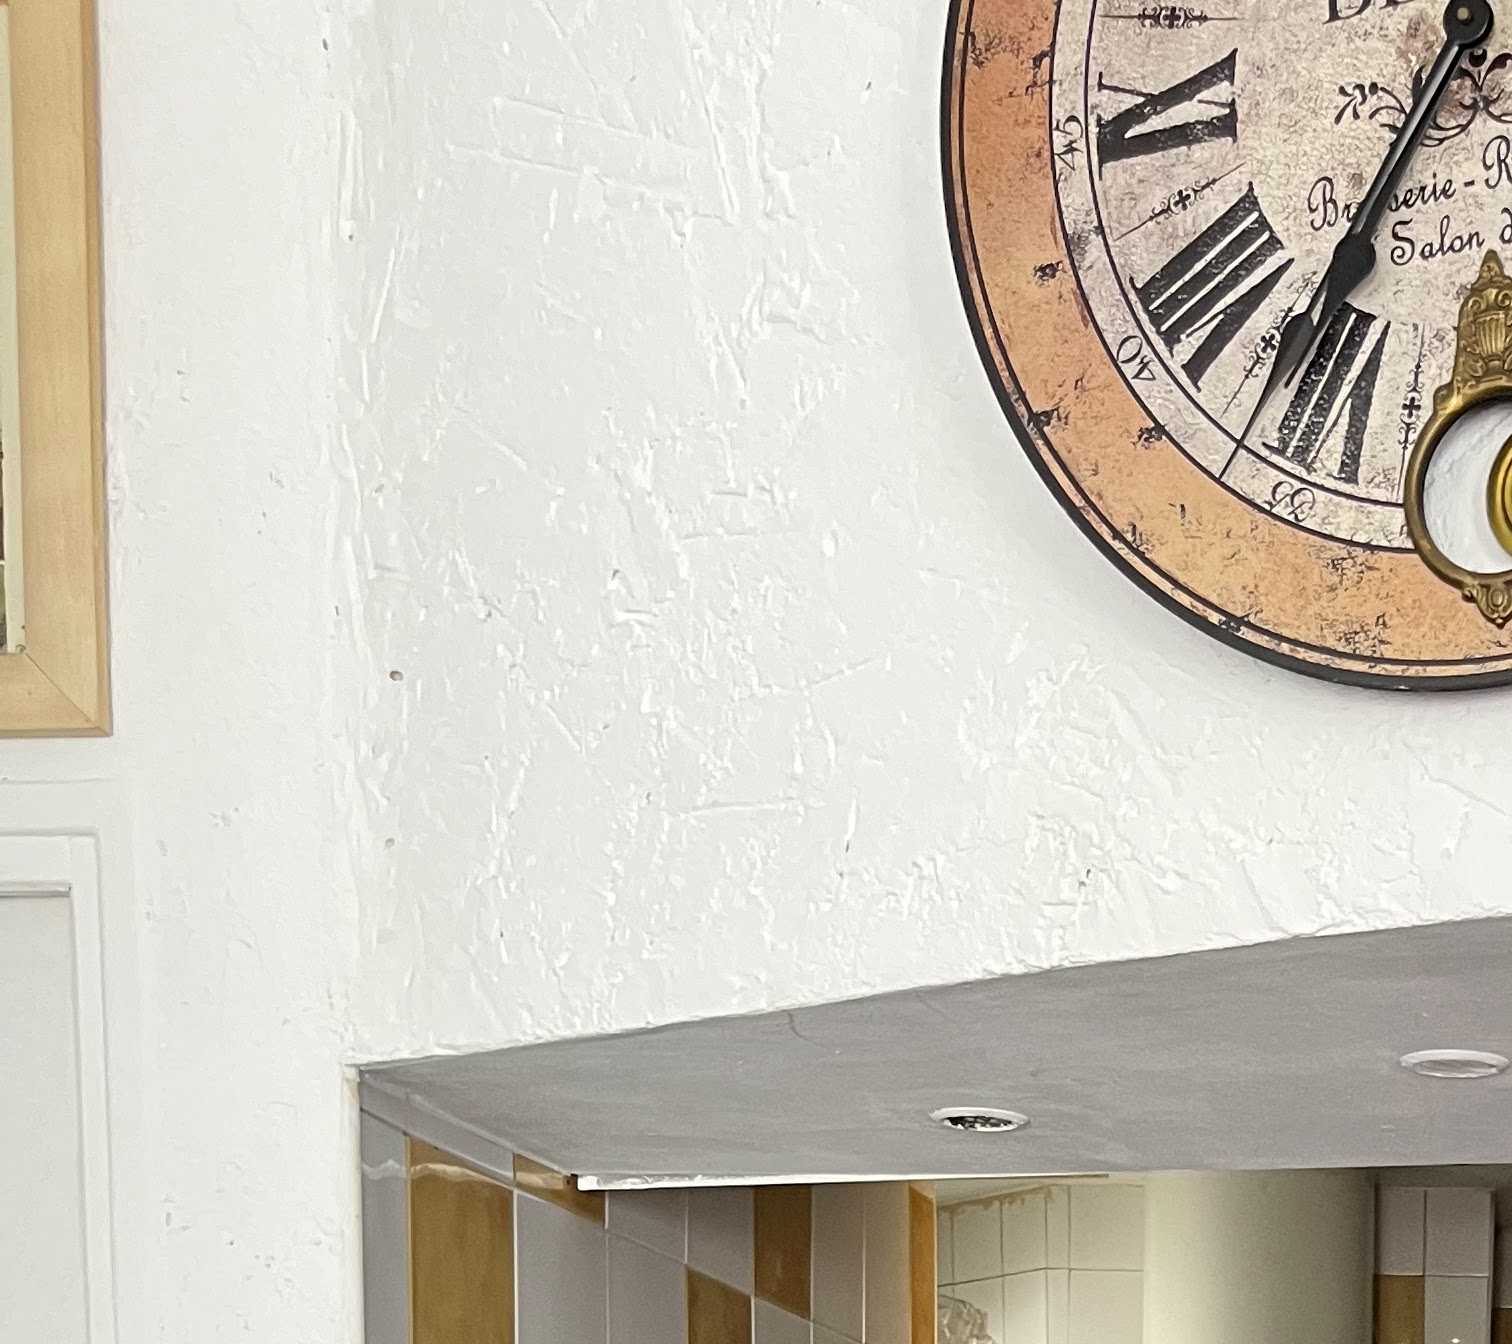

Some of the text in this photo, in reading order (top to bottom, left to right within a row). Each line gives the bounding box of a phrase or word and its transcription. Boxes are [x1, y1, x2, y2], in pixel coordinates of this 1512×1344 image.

[1053, 114, 1084, 172] 45
[1307, 173, 1457, 233] Brserie
[1389, 214, 1485, 267] Salon
[1115, 333, 1159, 384] 40
[1268, 478, 1317, 523] 35
